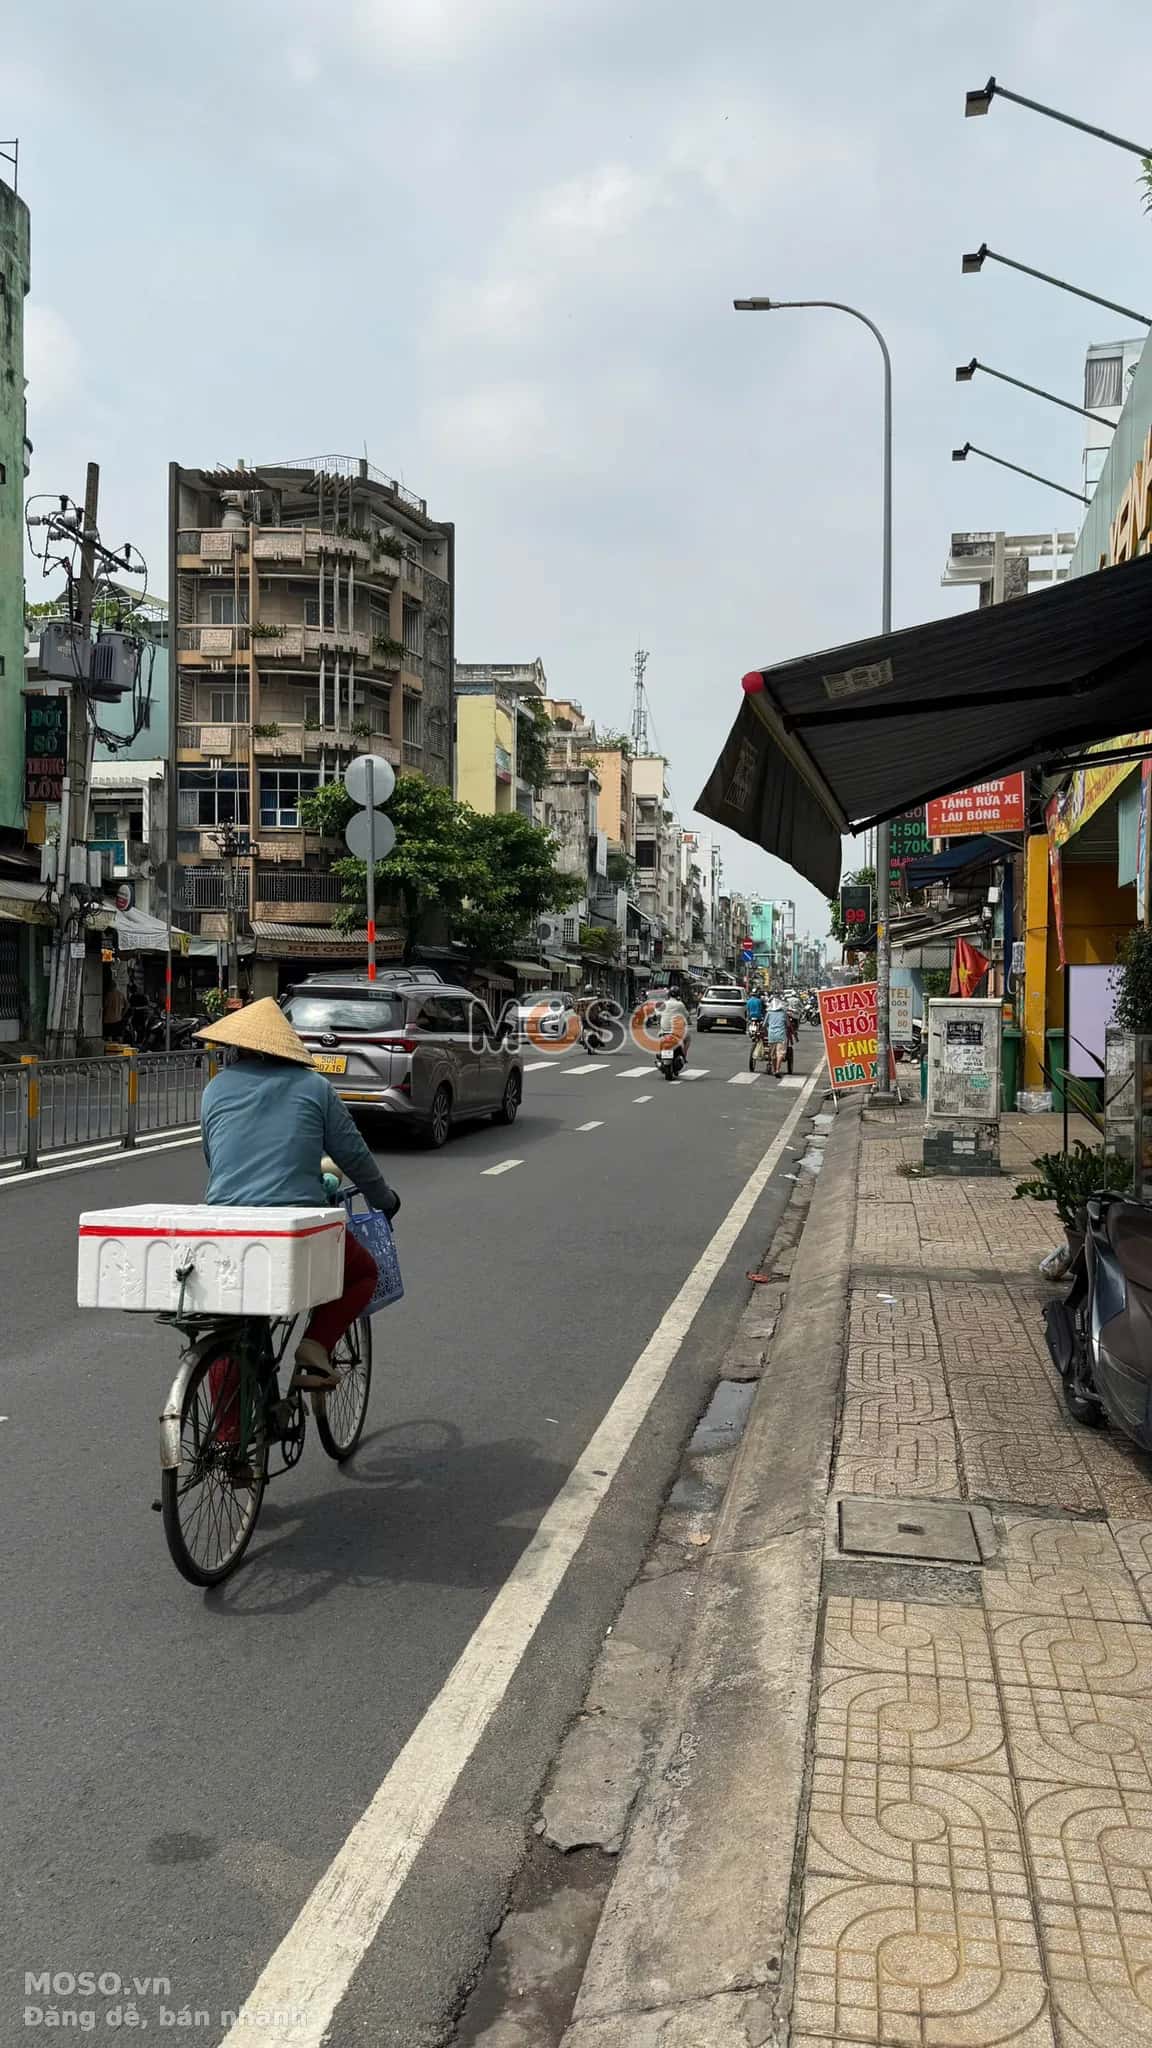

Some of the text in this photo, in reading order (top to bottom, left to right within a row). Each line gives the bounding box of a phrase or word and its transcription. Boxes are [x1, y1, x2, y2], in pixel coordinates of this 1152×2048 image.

[941, 797, 973, 812] TẶNG
[976, 793, 1001, 806] RỬA
[1004, 793, 1020, 804] XE
[942, 808, 1000, 823] LAU BÓNG
[823, 989, 877, 1013] THAY
[890, 988, 911, 999] TEL
[827, 1011, 877, 1038] NHỚT
[838, 1039, 878, 1061] TẶNG
[834, 1060, 878, 1082] RỬA X
